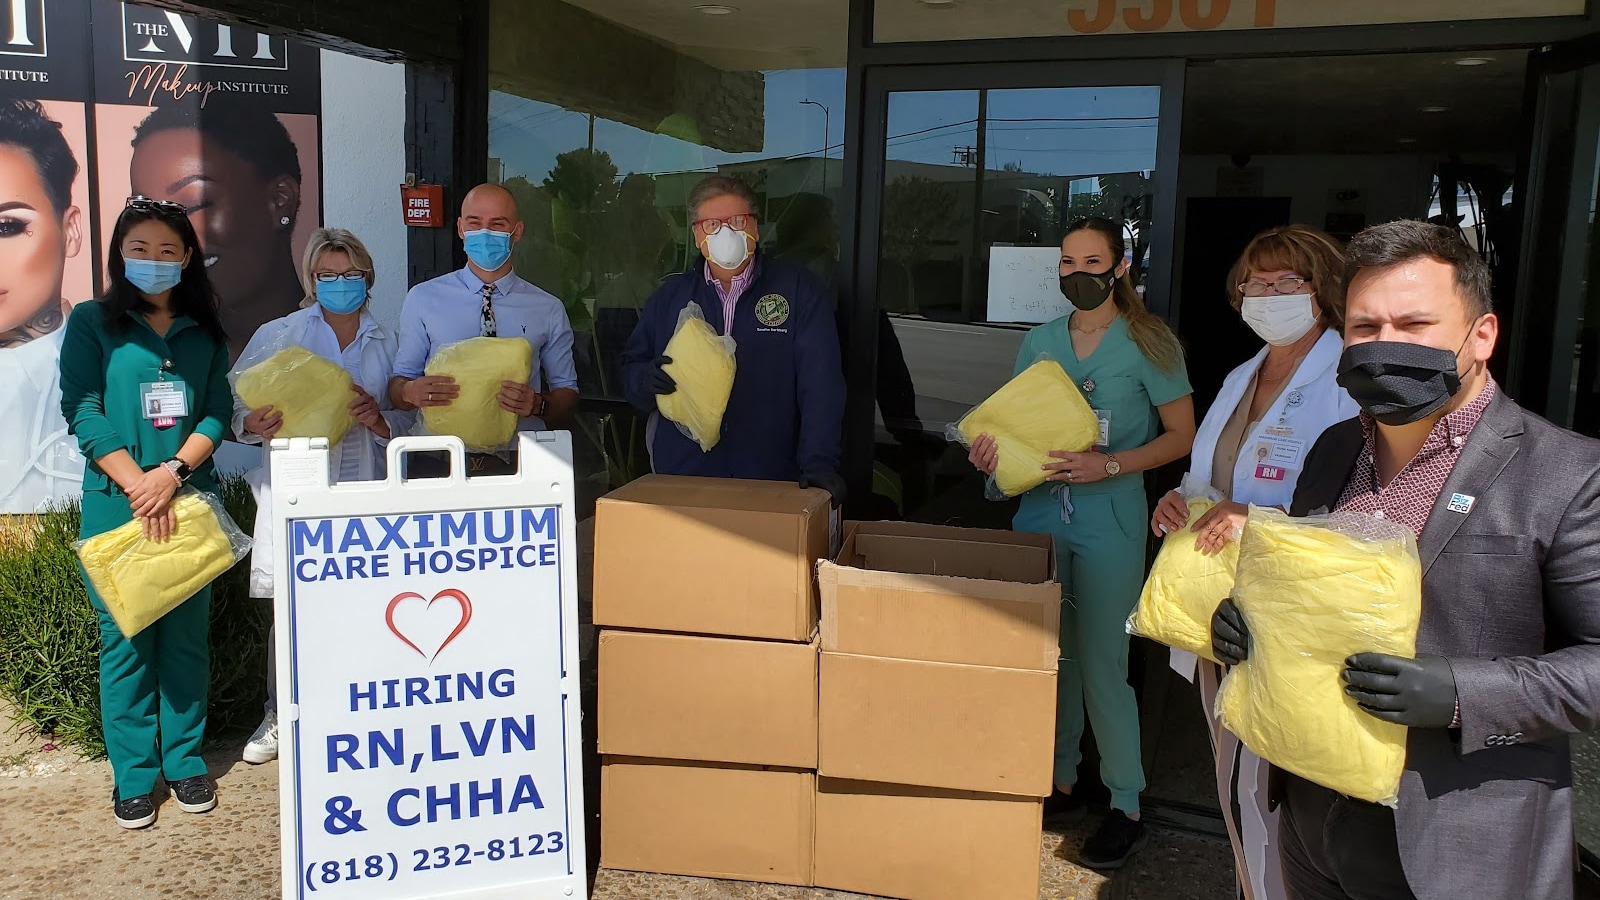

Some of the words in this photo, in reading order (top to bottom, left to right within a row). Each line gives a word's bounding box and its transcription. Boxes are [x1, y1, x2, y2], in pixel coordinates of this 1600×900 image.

[133, 22, 169, 37] THE
[125, 63, 218, 109] Makeup
[217, 81, 289, 95] INSTITUTE
[409, 198, 429, 207] FIRE
[1262, 467, 1278, 478] RN
[1449, 500, 1470, 511] Fed
[294, 507, 557, 556] MAXIMUM
[295, 553, 390, 583] CARE
[403, 543, 556, 576] HOSPICE
[349, 668, 515, 712] HIRING
[323, 795, 368, 835] &
[387, 774, 545, 827] CHHA
[305, 852, 399, 892] (818)
[413, 831, 564, 872] 232-8123
